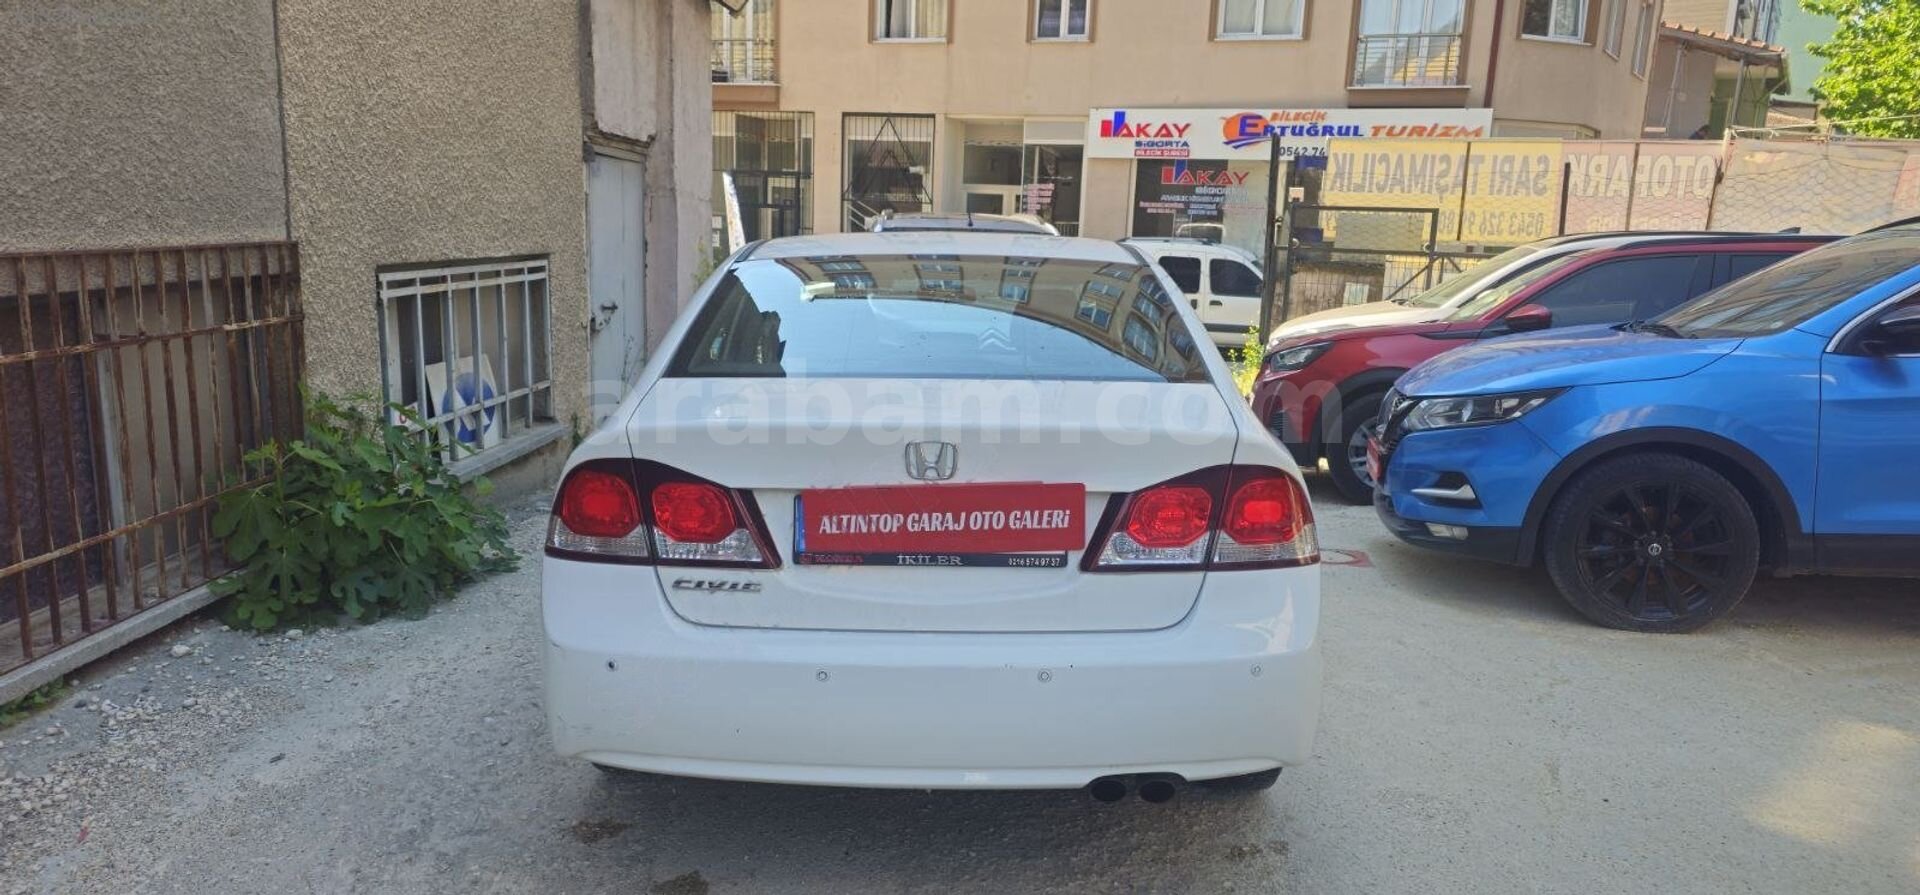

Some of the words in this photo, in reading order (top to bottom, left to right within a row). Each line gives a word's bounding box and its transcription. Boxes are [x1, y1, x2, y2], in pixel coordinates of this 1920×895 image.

[1269, 110, 1327, 122] BİLECİK
[1116, 122, 1191, 138] AKAY
[1239, 115, 1363, 137] ERTUĞRUL
[1371, 123, 1484, 137] TURİZM
[1280, 146, 1304, 157] 0542
[1312, 146, 1326, 157] 74
[1177, 170, 1250, 185] AKAY
[819, 513, 904, 534] ALTINTOP
[906, 512, 966, 532] GARAJ
[969, 511, 1005, 531] OTO
[897, 554, 963, 566] İKİLER
